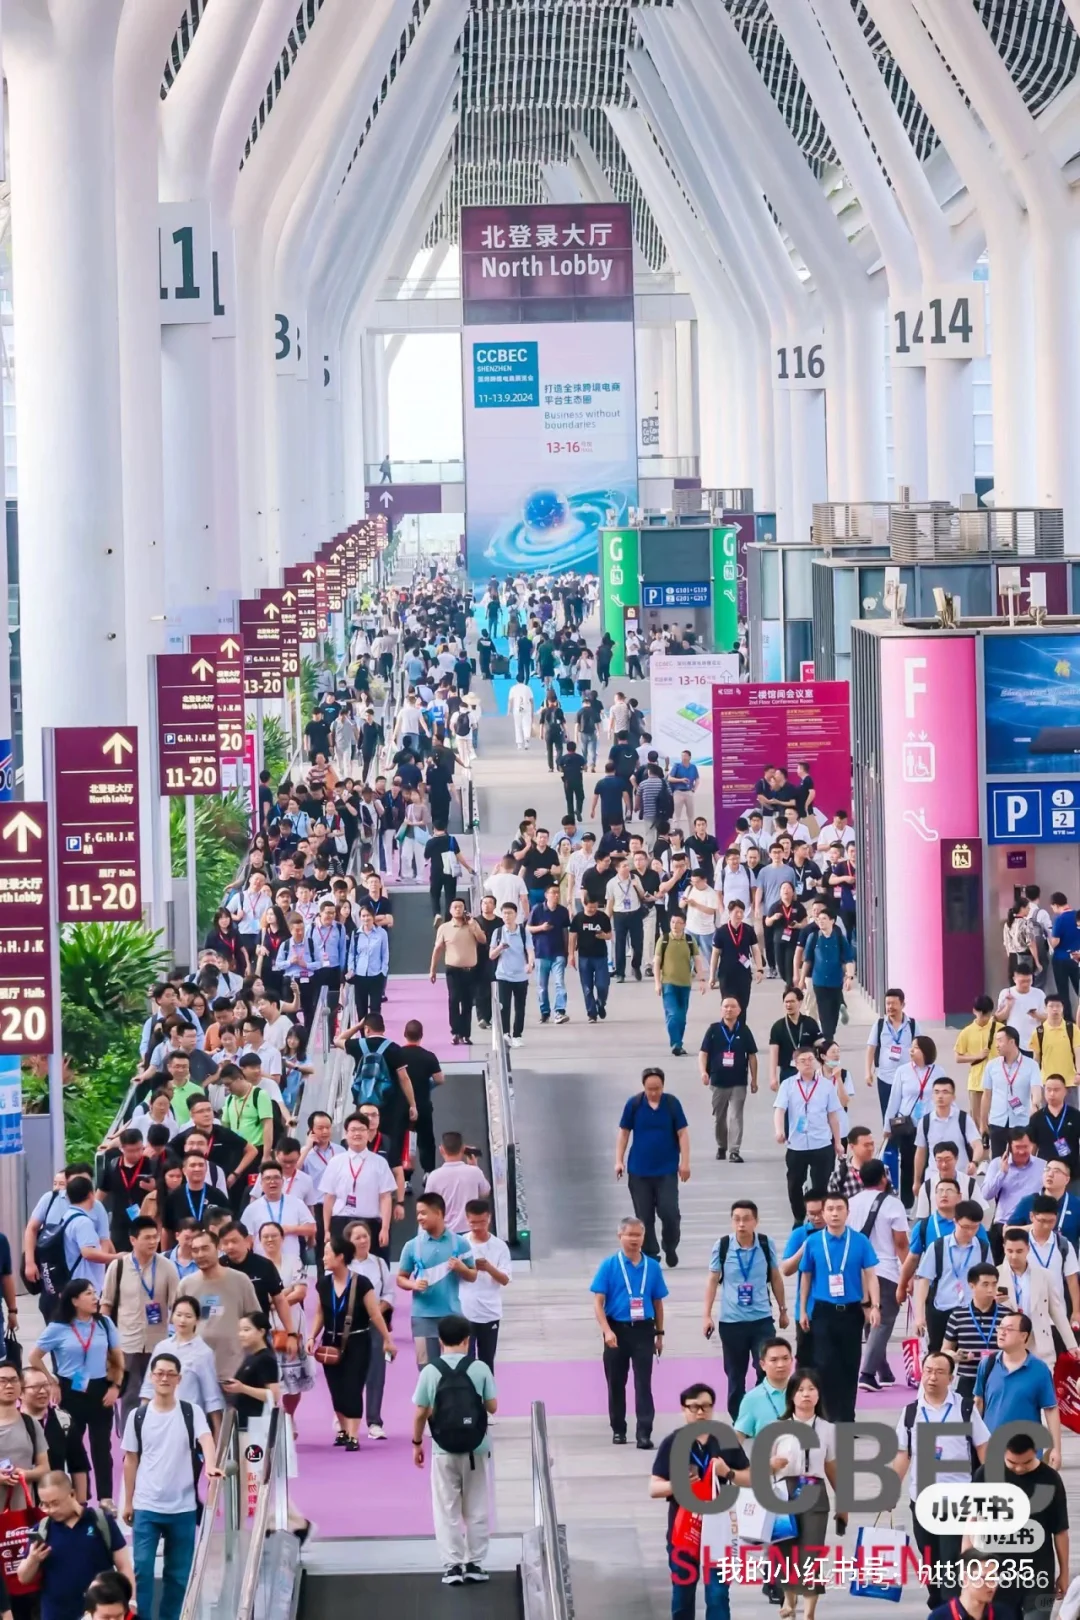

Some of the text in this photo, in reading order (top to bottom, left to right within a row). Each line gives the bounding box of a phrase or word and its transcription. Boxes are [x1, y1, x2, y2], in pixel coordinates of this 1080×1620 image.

[481, 223, 613, 249] 北登录大厅
[482, 253, 613, 281] North Lobby
[929, 298, 973, 344] 14
[477, 348, 528, 363] CCBEC
[544, 382, 621, 393] 打造全球跨境电商
[478, 392, 534, 403] 11-13.9.2024
[544, 395, 592, 405] 平台生态圈
[544, 409, 620, 420] Business without
[544, 420, 597, 430] boundaries
[546, 441, 580, 453] 13-16
[609, 536, 623, 561] G
[723, 532, 735, 557] G
[649, 589, 658, 604] P
[281, 659, 298, 672] 20
[243, 679, 281, 693] 13-20
[679, 675, 706, 685] 13-16
[749, 689, 814, 700] 二楼馆间会议室
[904, 657, 927, 718] F
[220, 733, 242, 750] 20
[165, 766, 217, 788] 11-20
[89, 784, 134, 793] 北登录大厅
[89, 794, 134, 805] North Lobby
[1056, 791, 1066, 805] -1
[1007, 795, 1028, 832] P
[1055, 812, 1067, 826] -2
[69, 838, 78, 848] P
[14, 891, 43, 905] Lobby
[66, 882, 137, 911] 11-20
[582, 922, 601, 931] FILA
